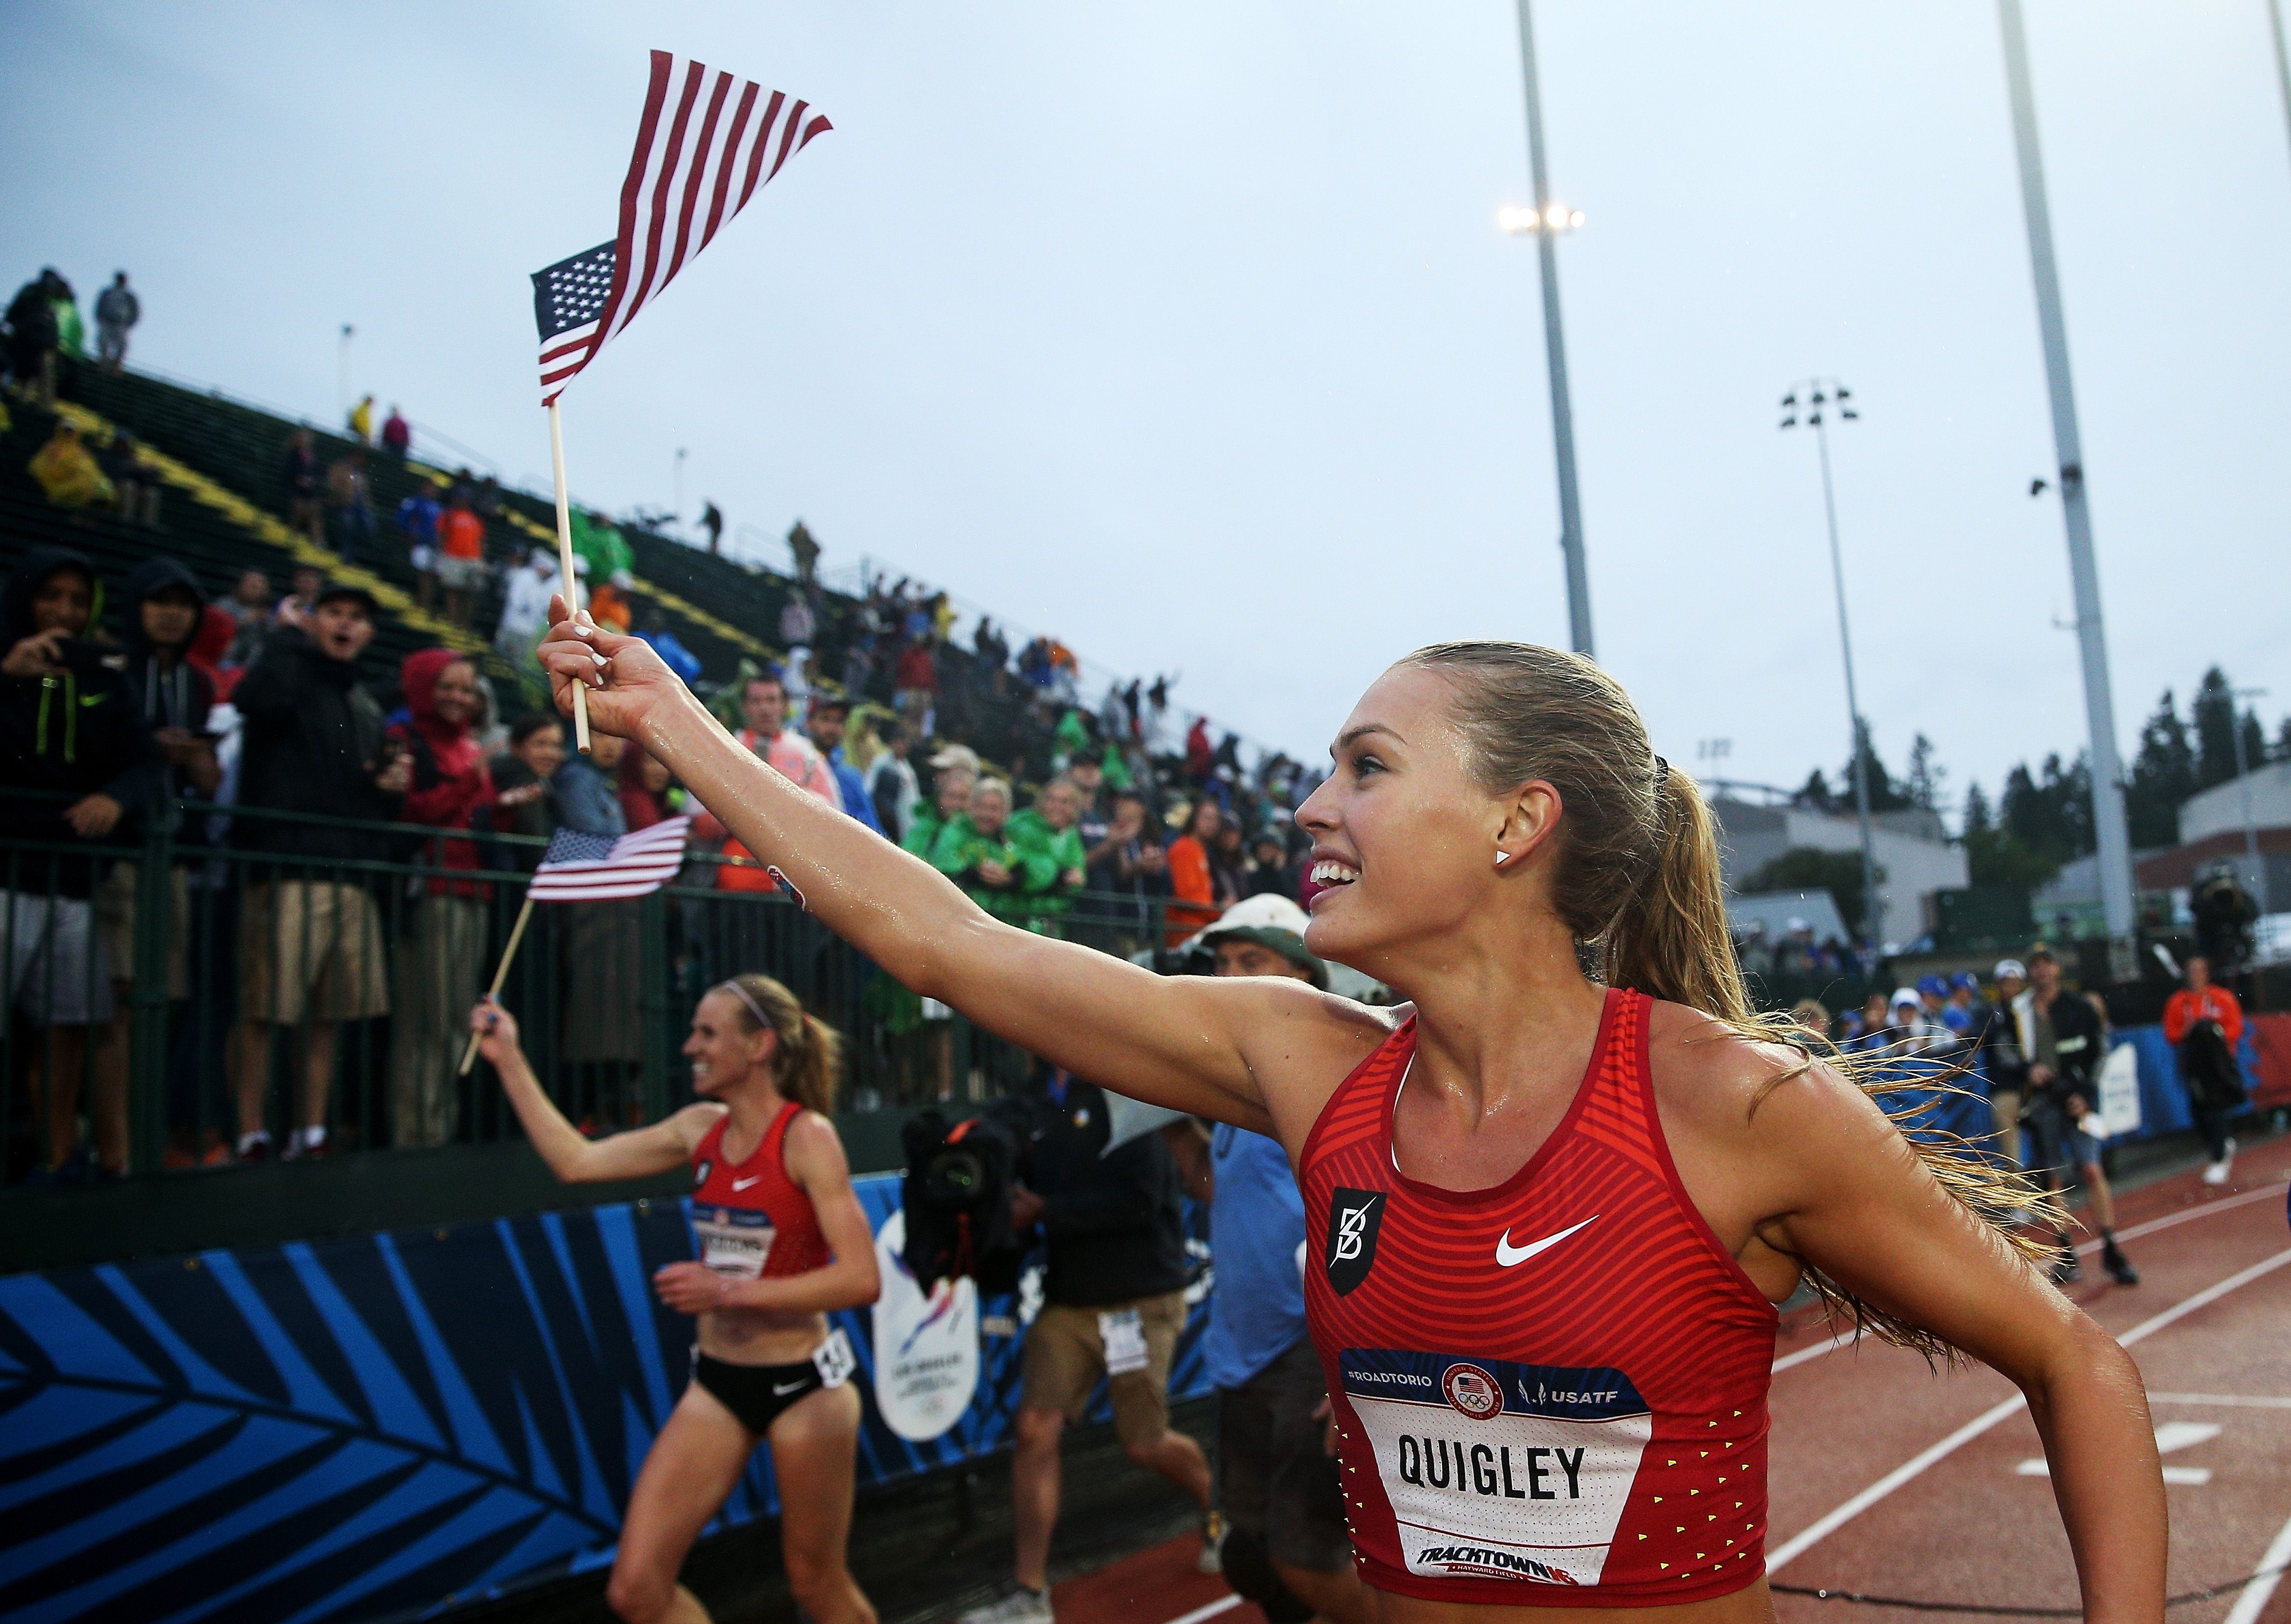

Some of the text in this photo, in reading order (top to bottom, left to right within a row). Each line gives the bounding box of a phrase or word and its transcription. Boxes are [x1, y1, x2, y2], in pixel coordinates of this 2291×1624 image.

[1348, 1370, 1432, 1387] #ROADTORIO
[1447, 1367, 1493, 1385] UNITED STATES
[1552, 1391, 1618, 1404] USATF
[1450, 1396, 1500, 1418] OLYMPIC TEAM
[1399, 1434, 1585, 1500] QUIGLEY
[1458, 1565, 1517, 1579] HAYWARD FIELD
